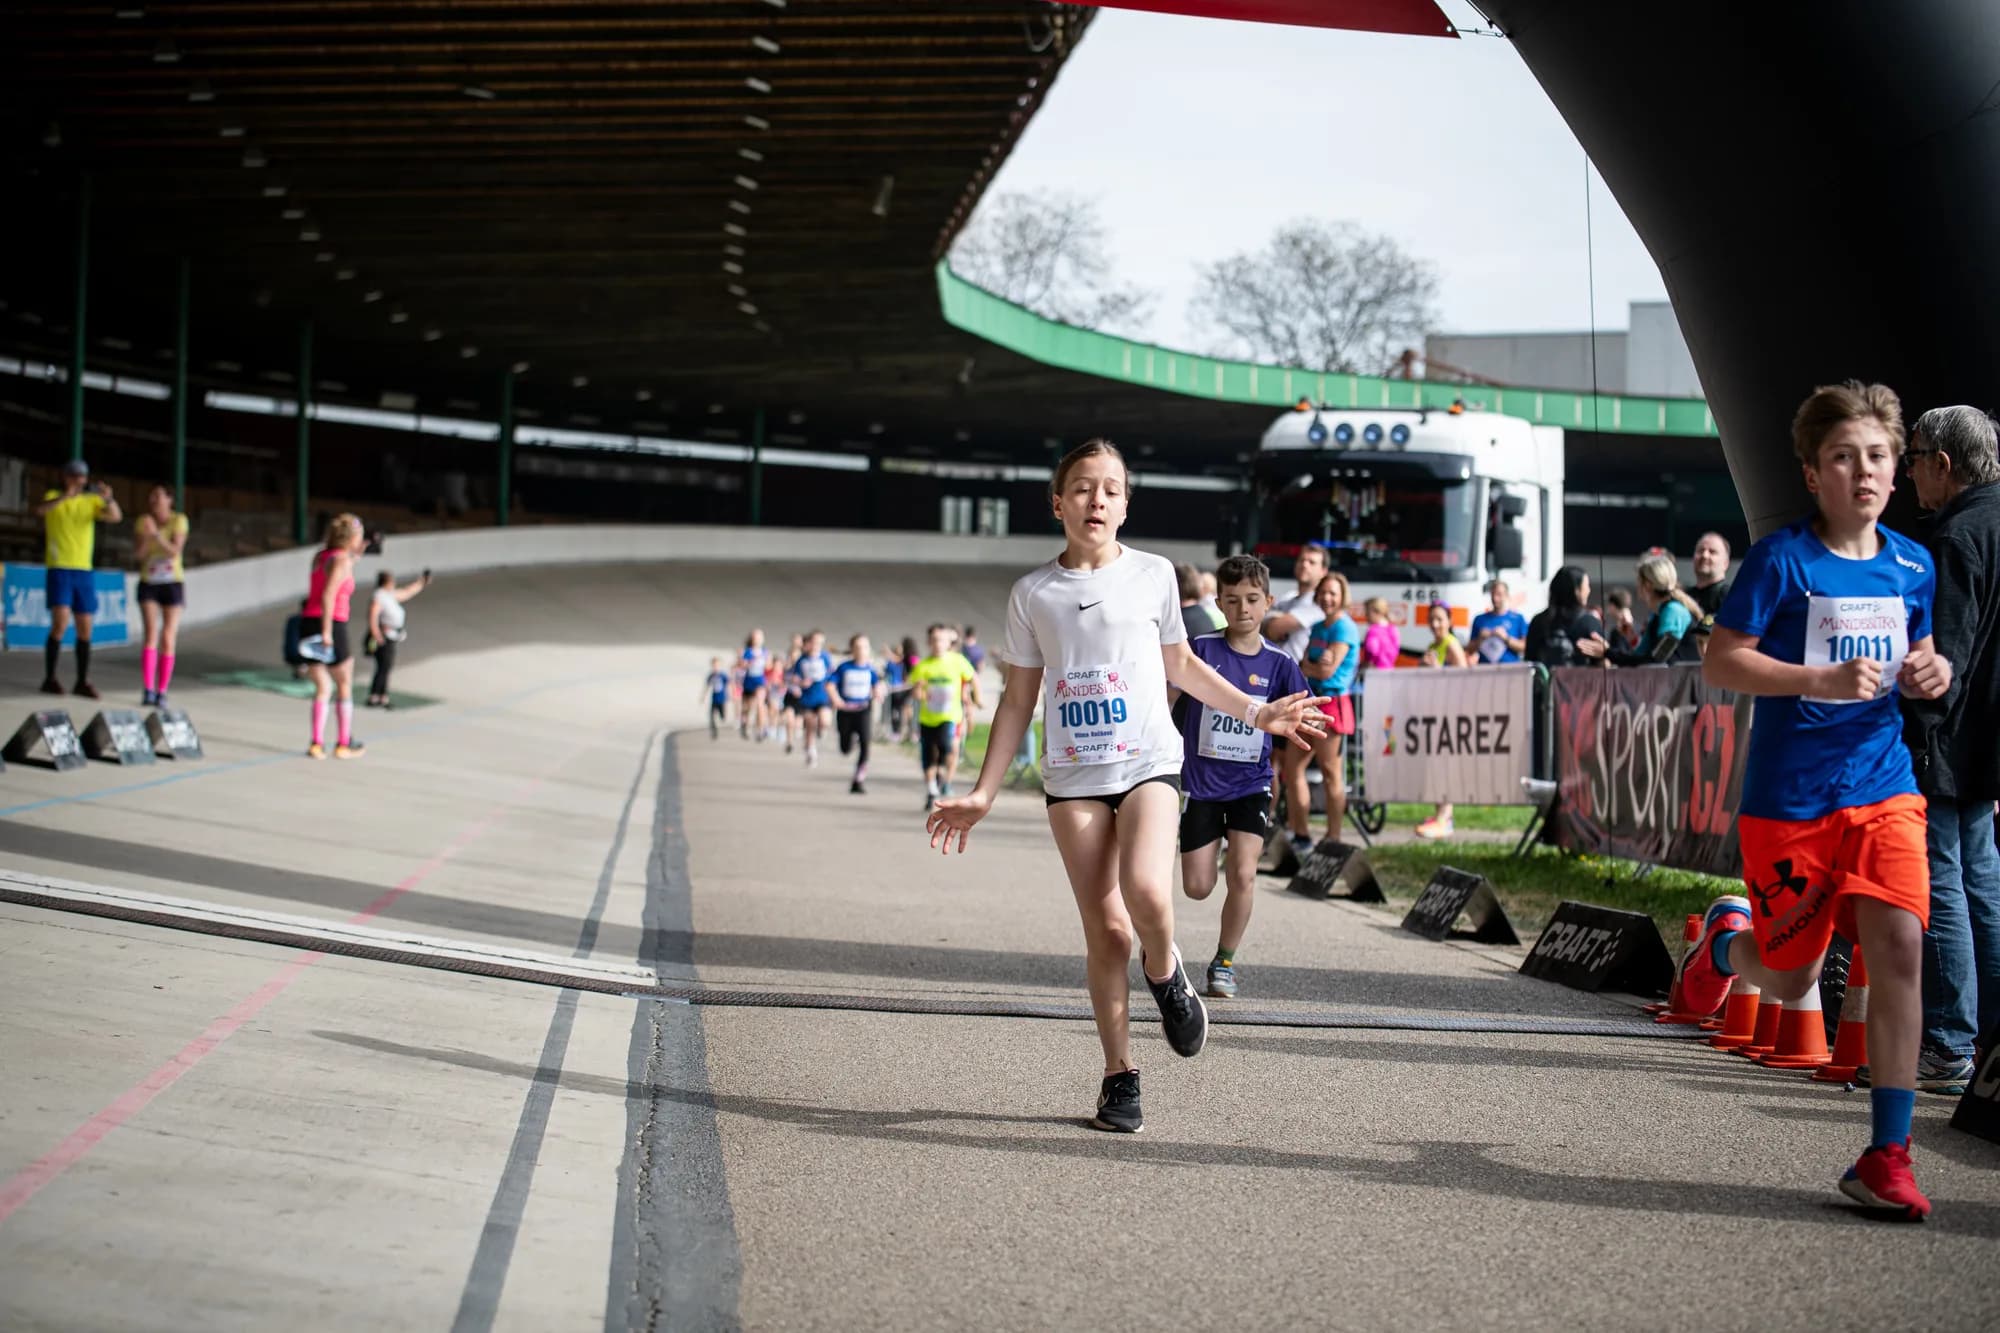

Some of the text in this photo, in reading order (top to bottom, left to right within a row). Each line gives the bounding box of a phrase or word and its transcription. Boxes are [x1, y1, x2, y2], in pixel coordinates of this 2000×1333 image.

[1840, 603, 1873, 612] CRAFT
[1826, 635, 1892, 662] 10011
[1067, 671, 1101, 680] CRAFT
[1058, 698, 1127, 728] 10019
[1211, 714, 1254, 736] 2039
[1405, 715, 1511, 756] STAREZ
[1075, 744, 1109, 753] CRAFT
[1535, 921, 1612, 966] CRAFT
